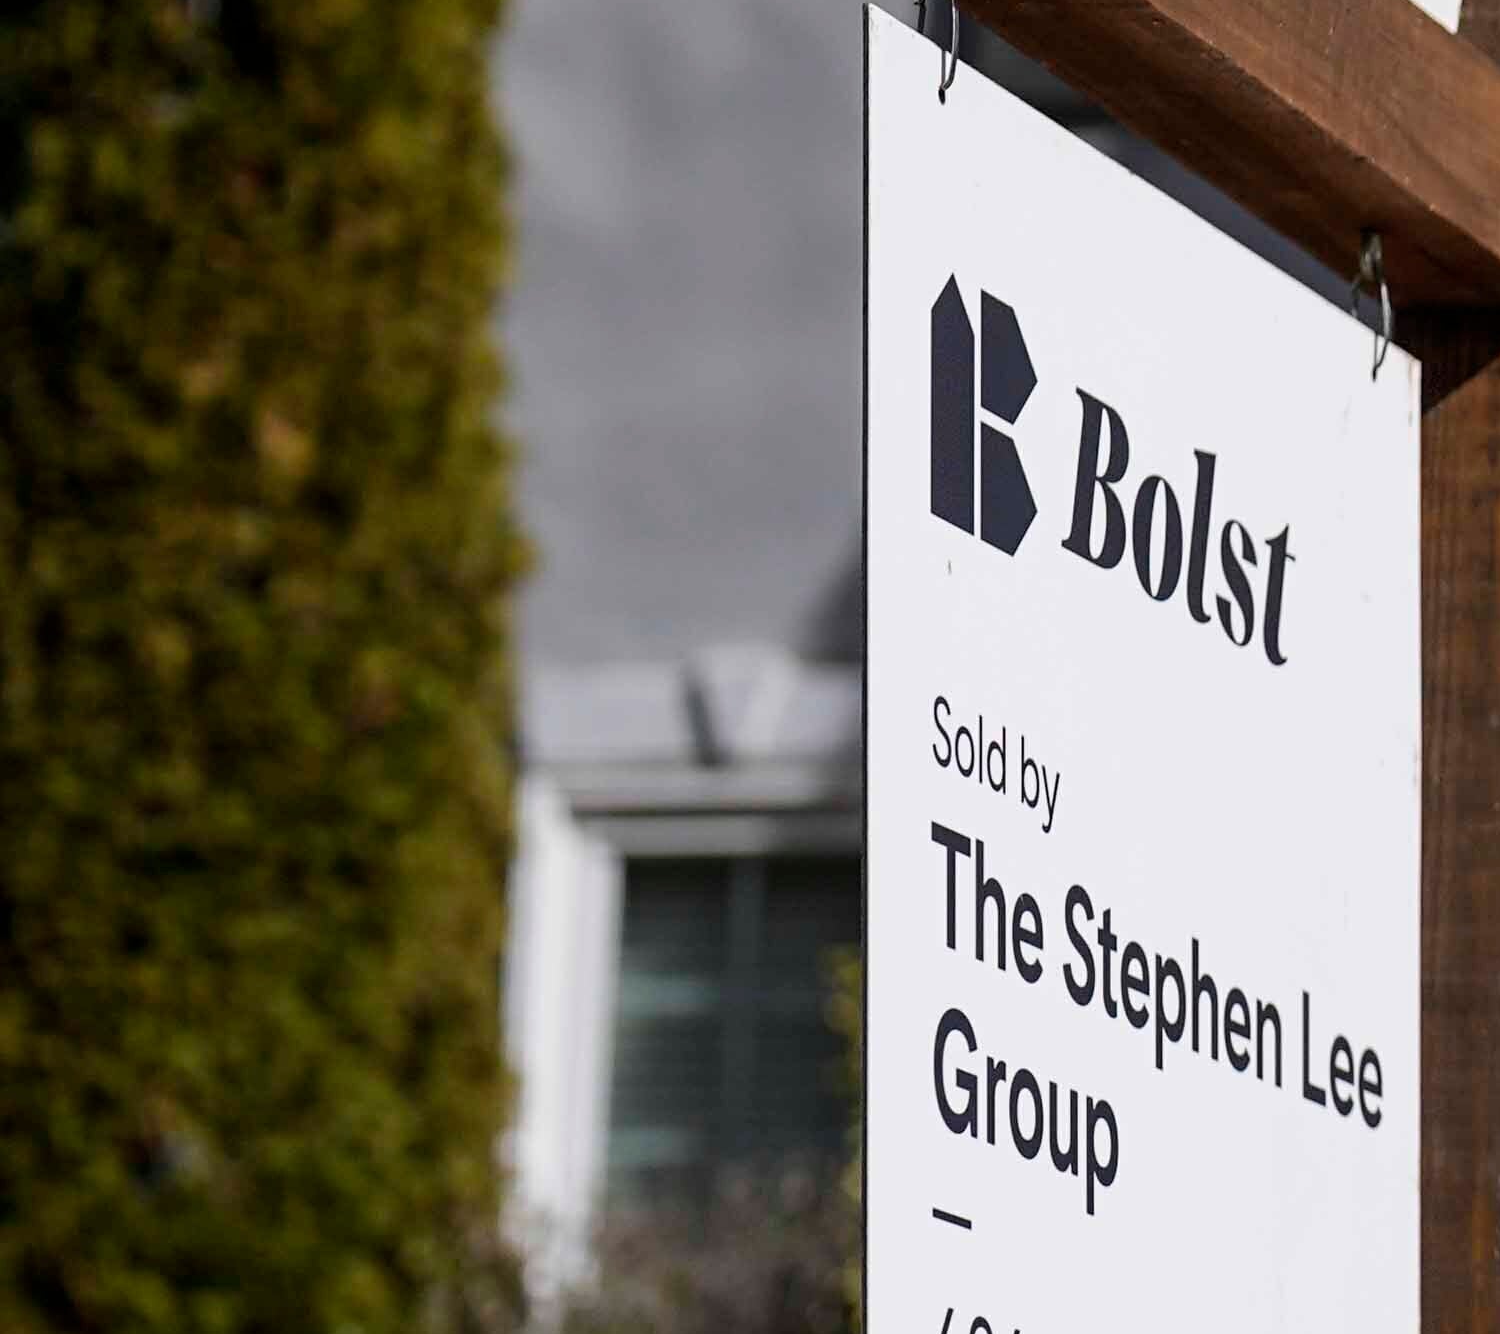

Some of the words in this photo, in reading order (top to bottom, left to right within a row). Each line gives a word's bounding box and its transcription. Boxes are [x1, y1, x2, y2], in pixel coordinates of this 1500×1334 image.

[1060, 386, 1297, 667] Bolst
[932, 695, 1006, 796] Sold
[1020, 734, 1061, 834] by
[930, 820, 1044, 985] The
[1062, 884, 1283, 1089] Stephen
[1302, 990, 1384, 1130] Lee
[933, 1007, 1119, 1217] Group
